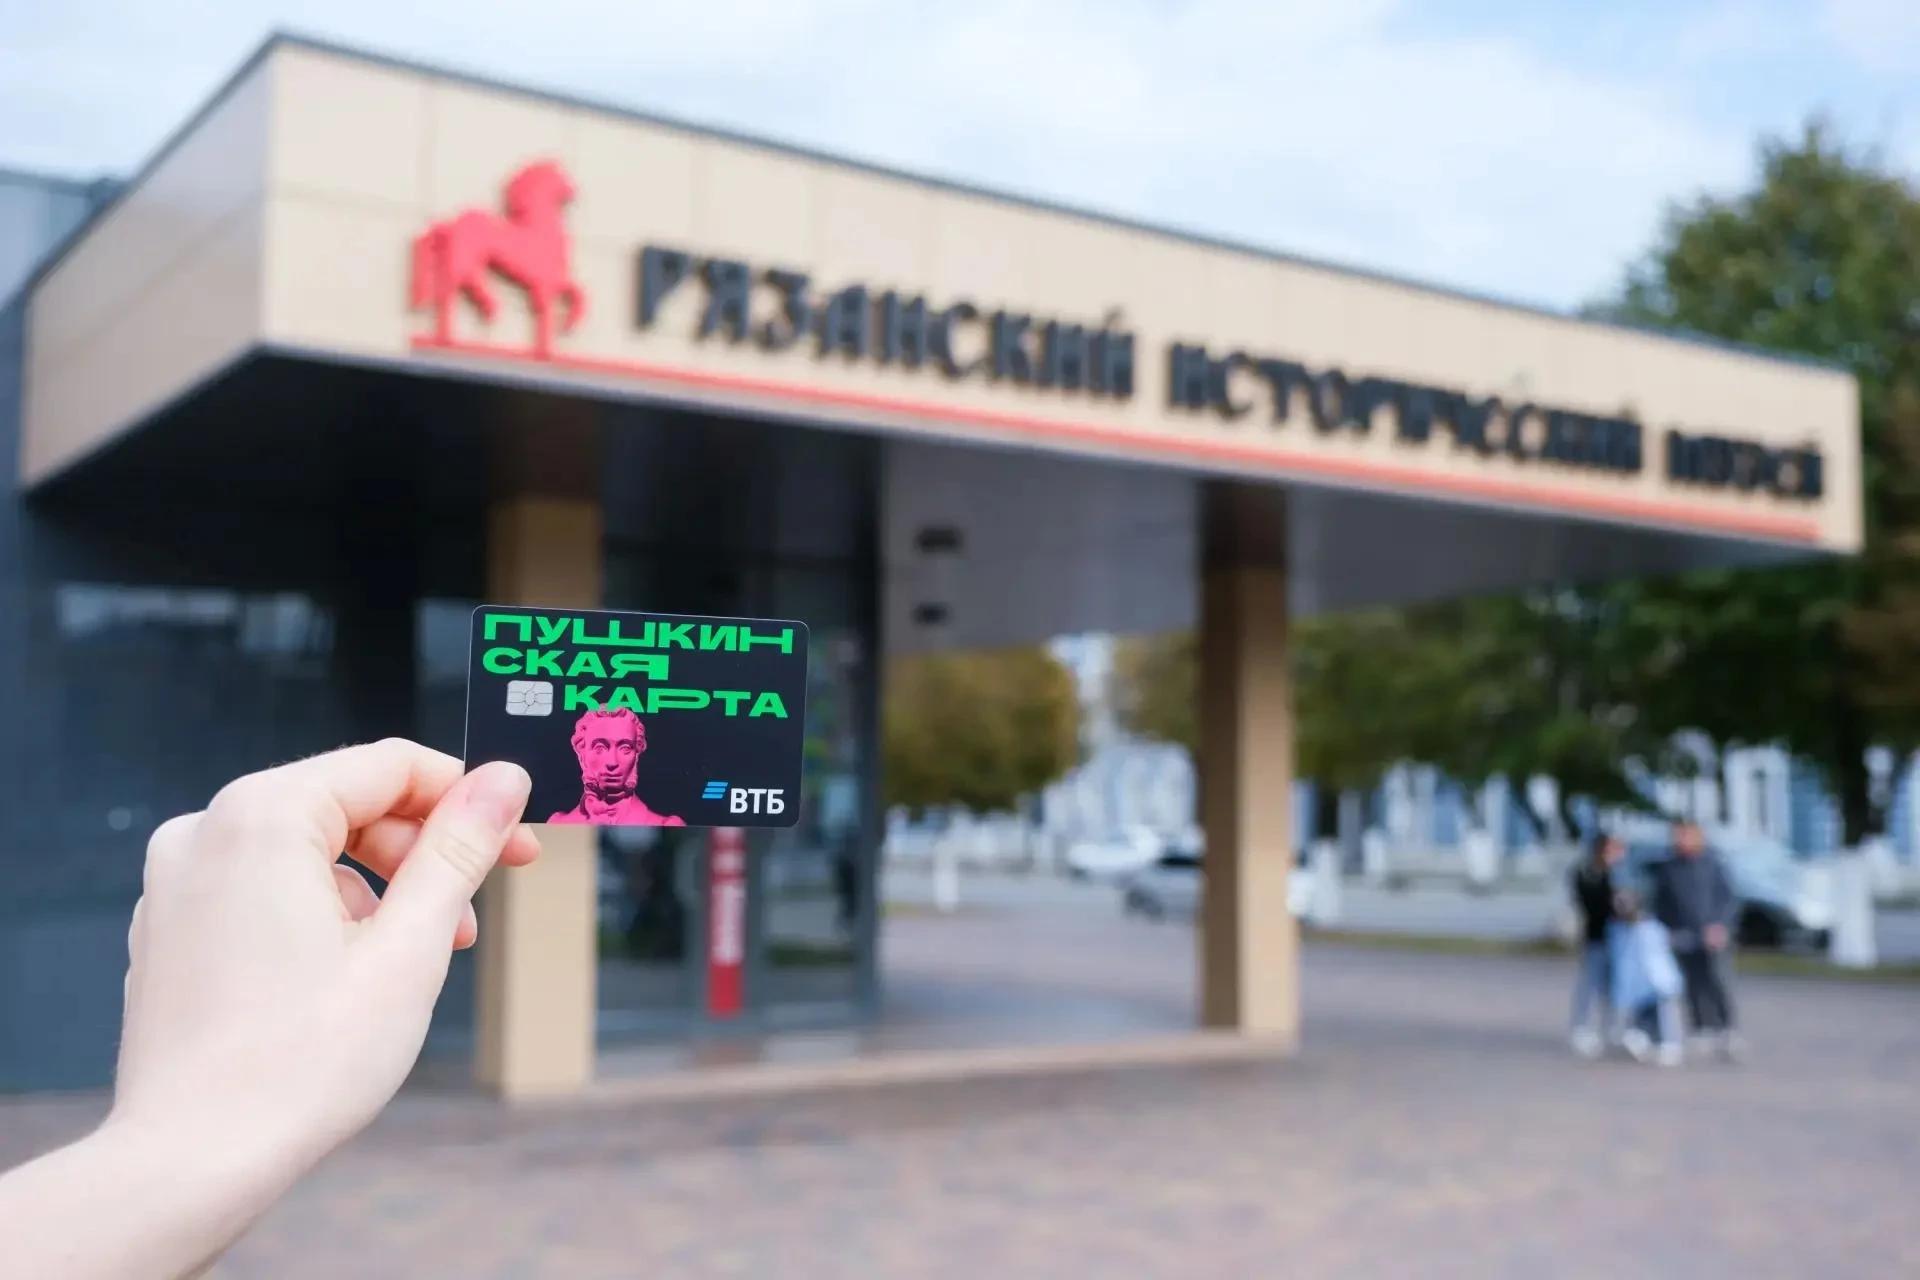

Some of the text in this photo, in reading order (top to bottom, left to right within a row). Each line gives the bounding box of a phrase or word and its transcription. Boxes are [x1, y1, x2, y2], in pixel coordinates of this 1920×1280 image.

[637, 246, 1136, 399] РЯЗАНСКИЙ
[484, 614, 794, 653] ПУШКИН
[482, 647, 669, 680] СКАЯ
[564, 685, 788, 718] КАРТА
[729, 788, 785, 814] ВТБ
